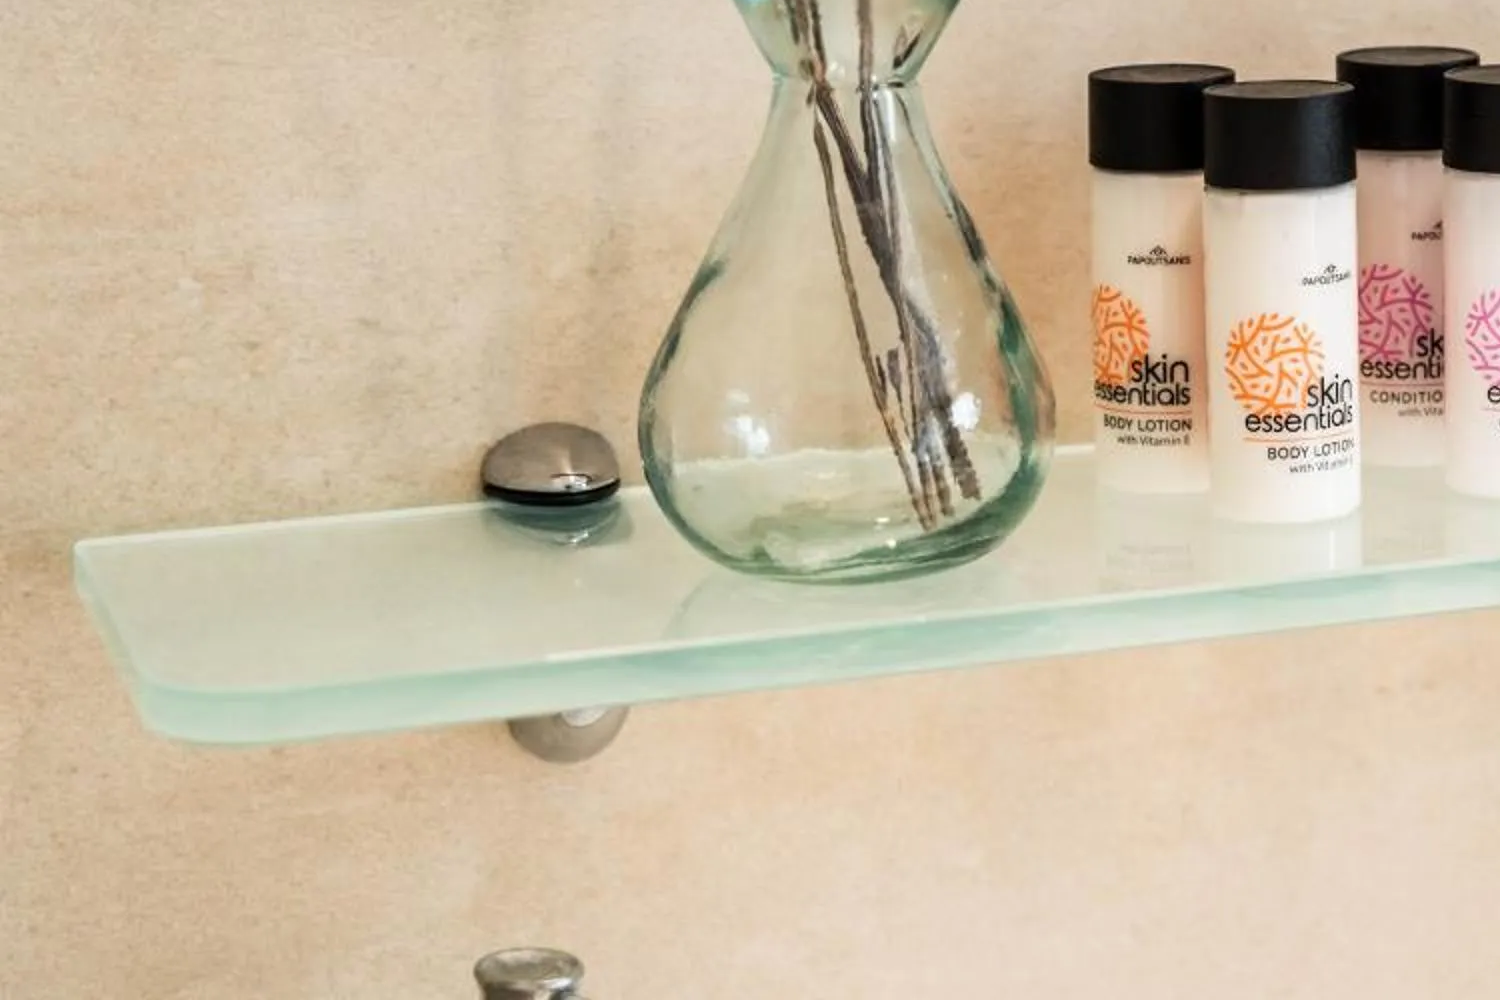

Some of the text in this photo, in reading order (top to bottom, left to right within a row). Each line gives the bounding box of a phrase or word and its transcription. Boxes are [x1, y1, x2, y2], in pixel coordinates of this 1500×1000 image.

[1416, 327, 1444, 358] sk
[1131, 354, 1190, 384] skin
[1360, 356, 1444, 380] essenti
[1094, 378, 1192, 406] essentials
[1307, 373, 1353, 408] skin
[1370, 390, 1443, 405] CONDITIO
[1103, 413, 1193, 433] BODY LOTION
[1245, 402, 1353, 433] essentials
[1267, 437, 1355, 461] BODY LOTION
